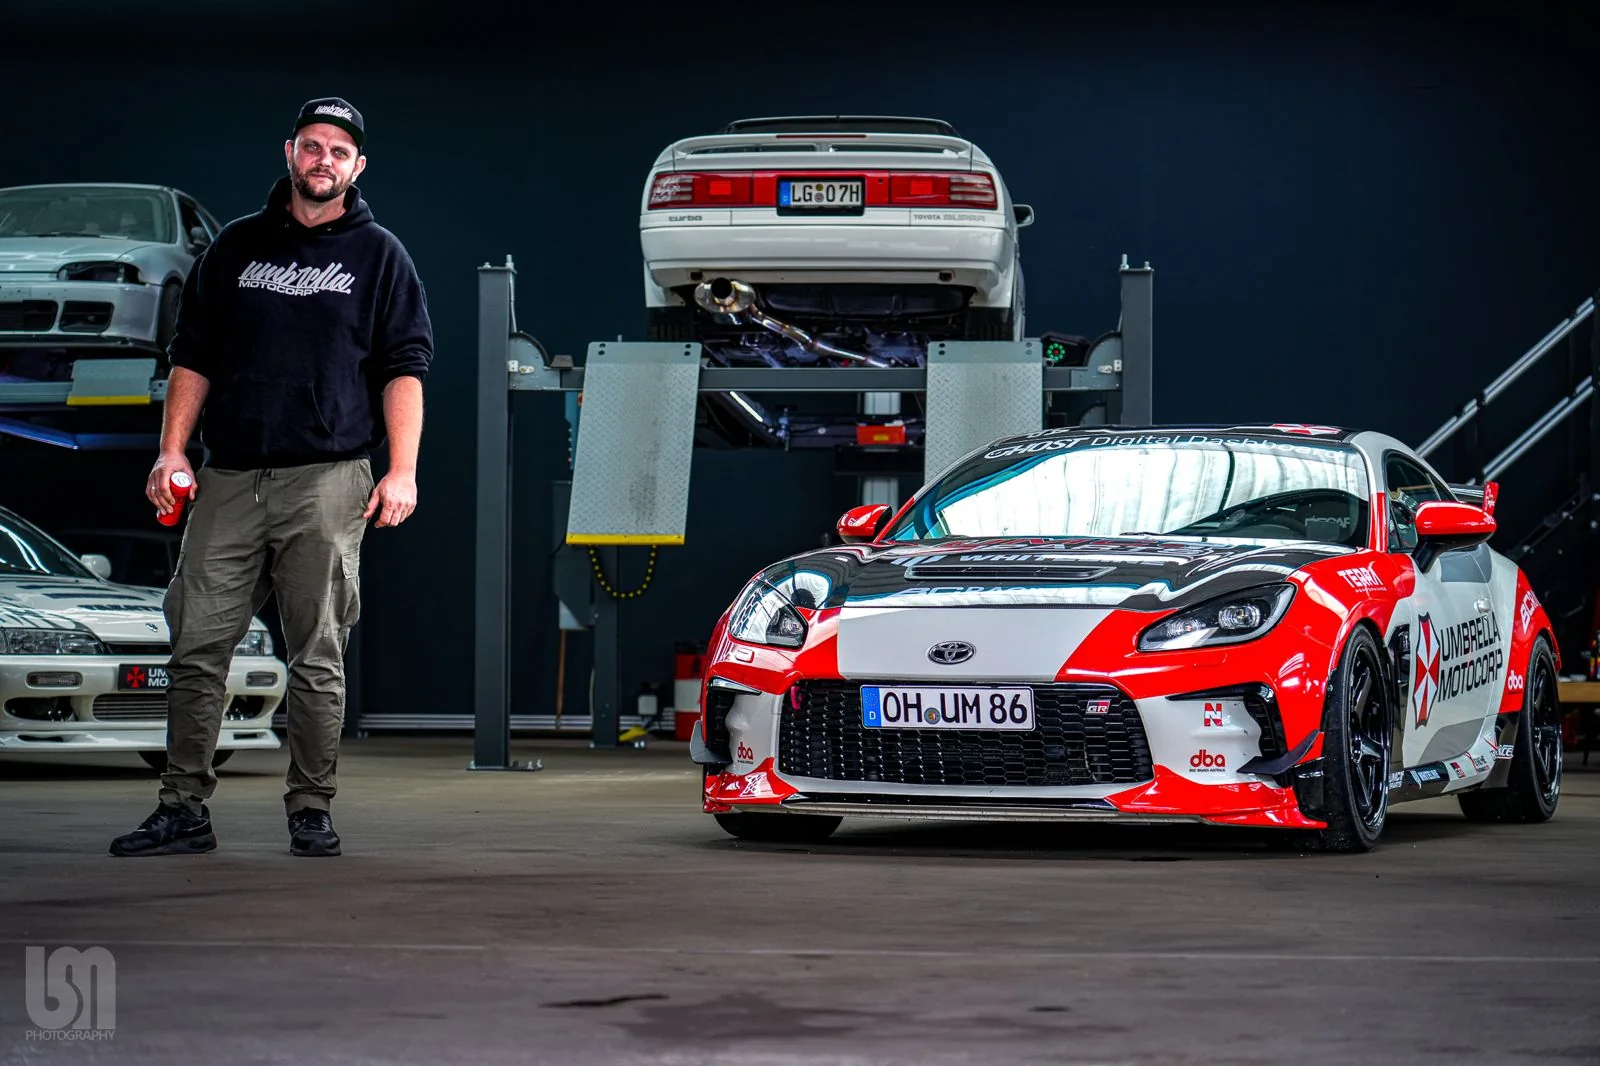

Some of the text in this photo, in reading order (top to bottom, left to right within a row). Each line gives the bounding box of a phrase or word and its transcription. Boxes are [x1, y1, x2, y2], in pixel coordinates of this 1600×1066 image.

[791, 184, 813, 203] LG
[668, 214, 702, 222] turbo
[238, 280, 314, 296] MOTOCORP
[985, 435, 1345, 460] GHOST Digital Dashboard
[1440, 611, 1501, 662] UMBRELLA
[1437, 648, 1503, 702] MOTOCORP
[1507, 669, 1524, 690] dba
[869, 691, 1028, 724] D OH UM 86
[1088, 704, 1109, 713] GR
[737, 741, 754, 760] dba
[1189, 749, 1226, 768] dba
